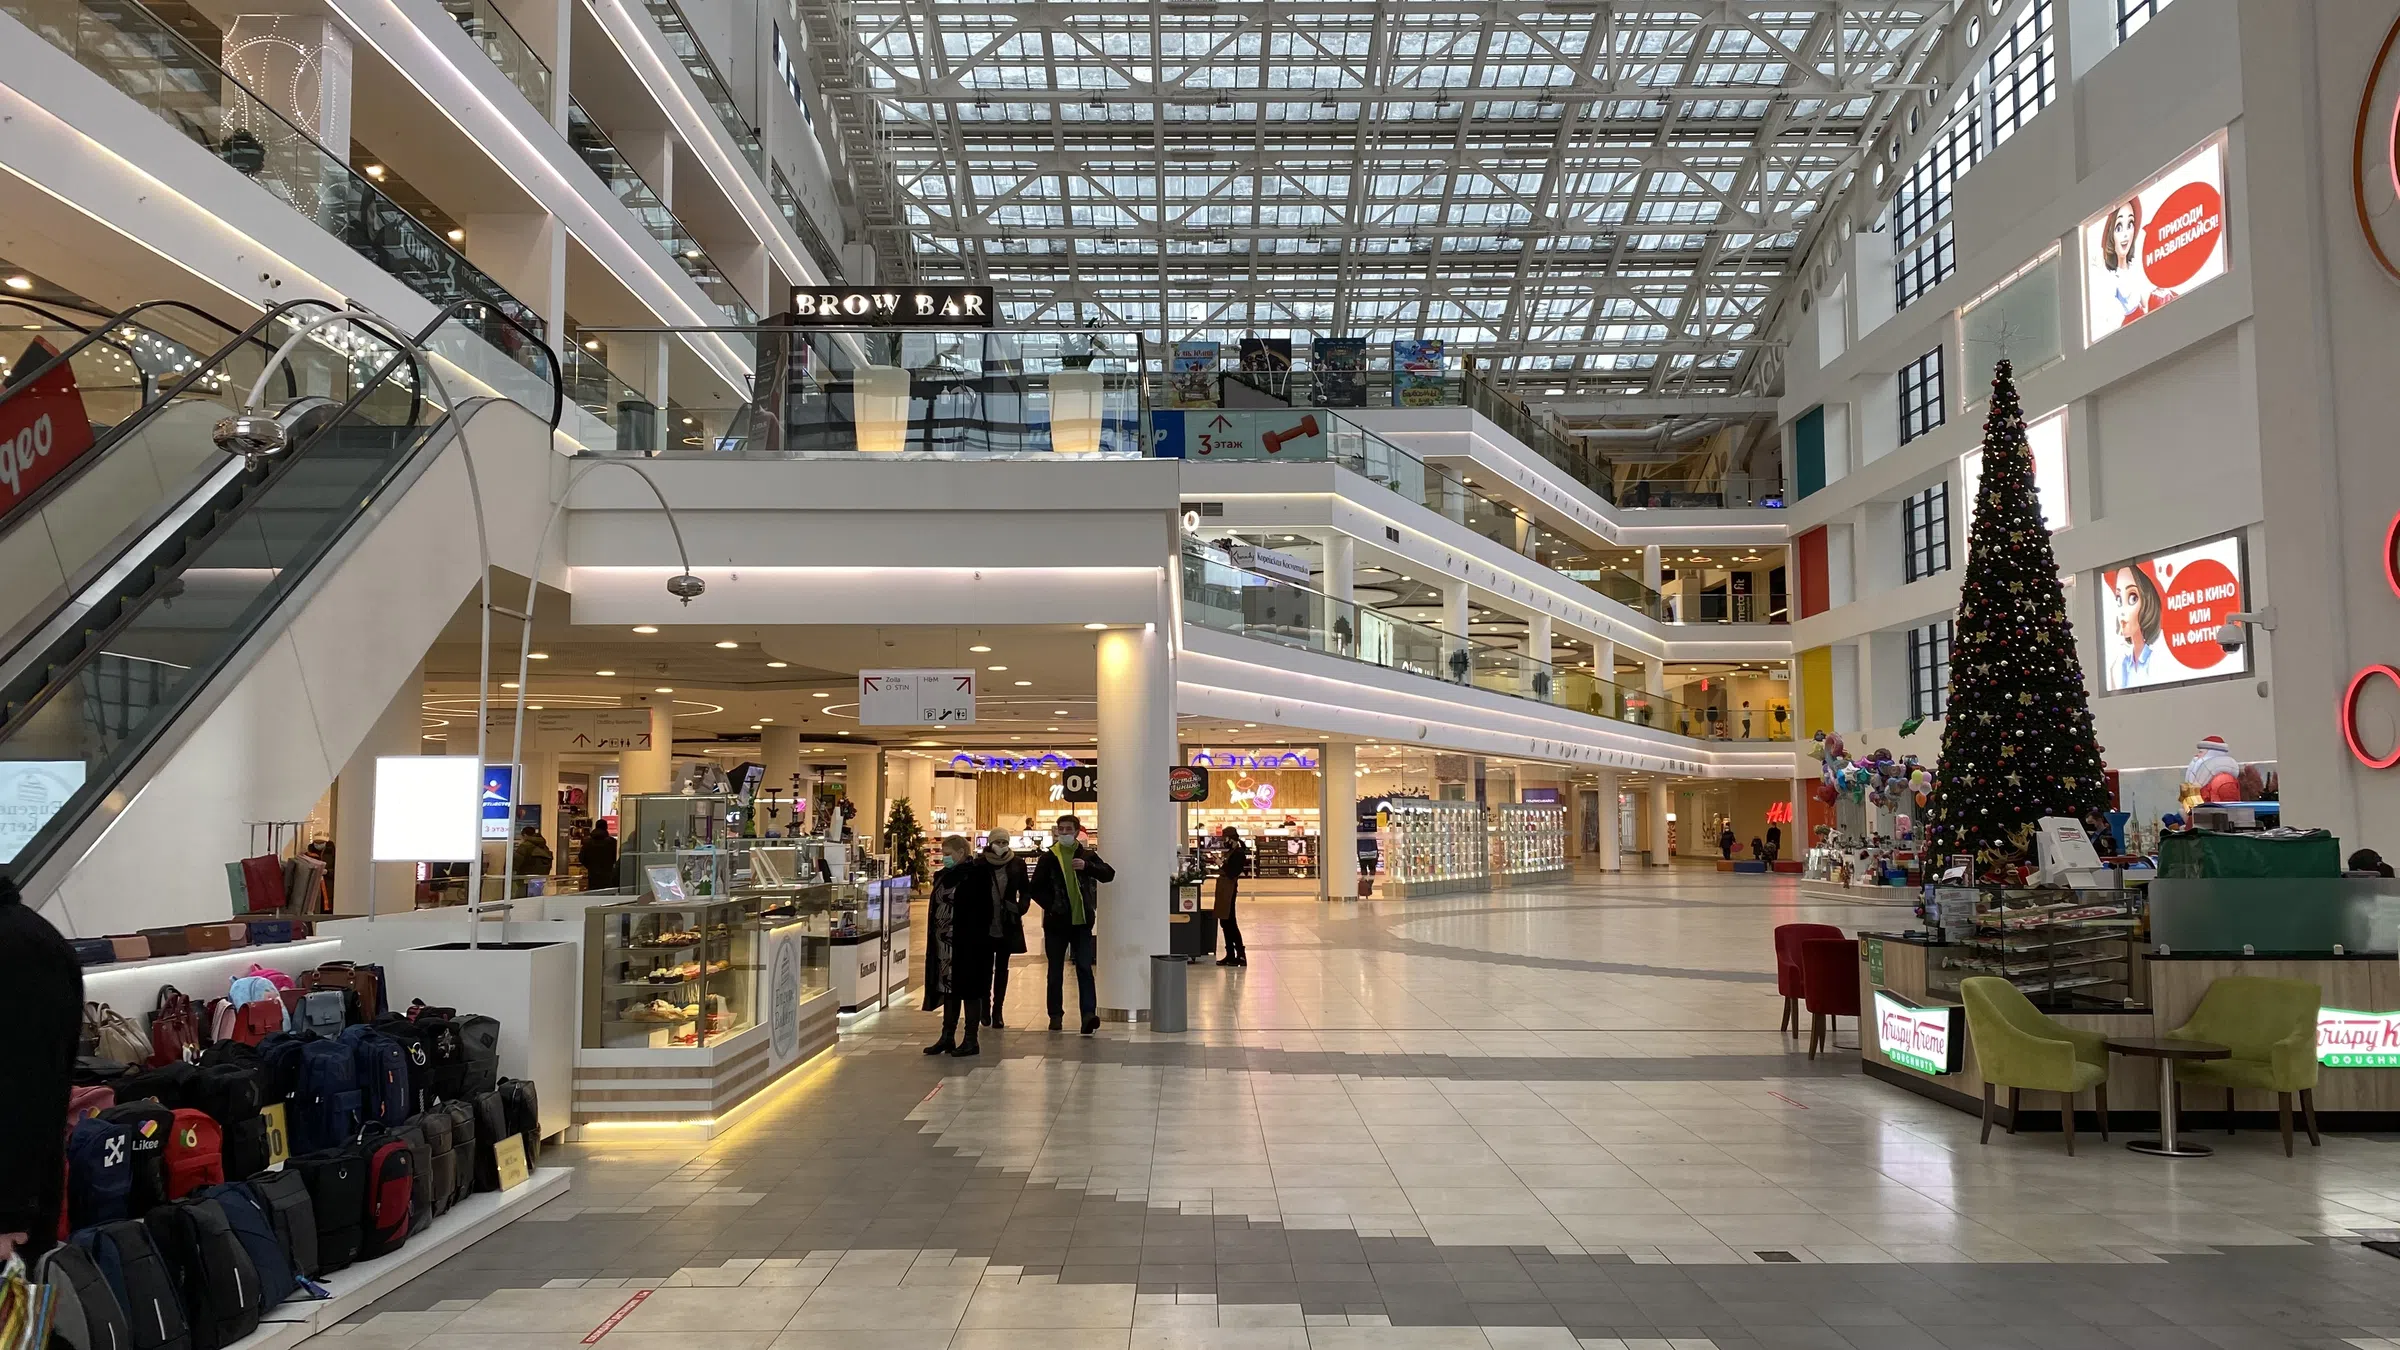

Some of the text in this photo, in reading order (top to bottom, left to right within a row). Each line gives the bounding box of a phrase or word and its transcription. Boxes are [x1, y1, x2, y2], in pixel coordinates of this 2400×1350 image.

[2158, 204, 2203, 241] ПРИХОДИ
[2146, 213, 2219, 267] И РАЗВЛЕКАЙСЯ!
[796, 294, 986, 316] BROW BAR
[1197, 434, 1243, 455] 3 этаж
[2167, 582, 2235, 611] ИДЁМ В КИНО
[2189, 607, 2211, 625] ИЛИ
[2172, 632, 2187, 647] НА
[1882, 1010, 1945, 1055] Krispy Kreme
[1891, 1050, 1934, 1073] DOUGHNUTS
[132, 1138, 159, 1151] Likee
